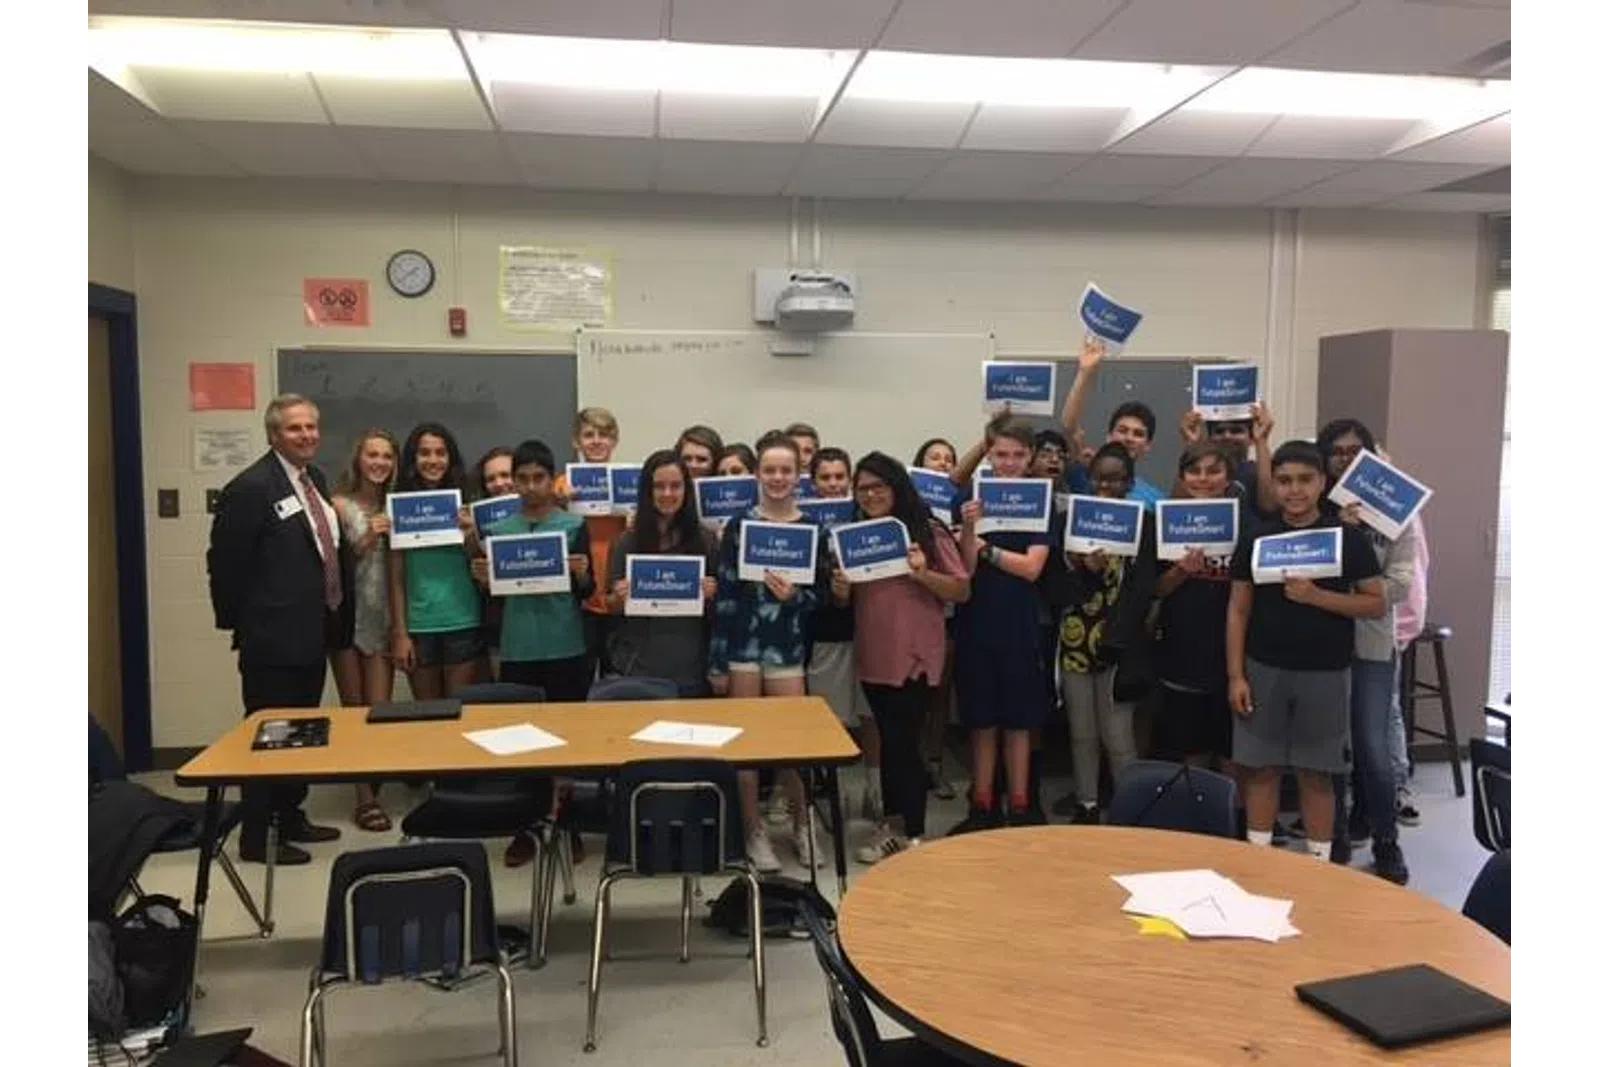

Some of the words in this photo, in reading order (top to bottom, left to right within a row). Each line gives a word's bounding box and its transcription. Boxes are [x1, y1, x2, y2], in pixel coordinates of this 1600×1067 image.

[1015, 376, 1028, 384] am
[1223, 379, 1235, 387] am
[1382, 481, 1396, 493] am
[1009, 494, 1023, 502] am
[774, 538, 789, 546] am
[868, 535, 881, 543] am
[523, 550, 538, 558] am
[661, 571, 676, 580] am
